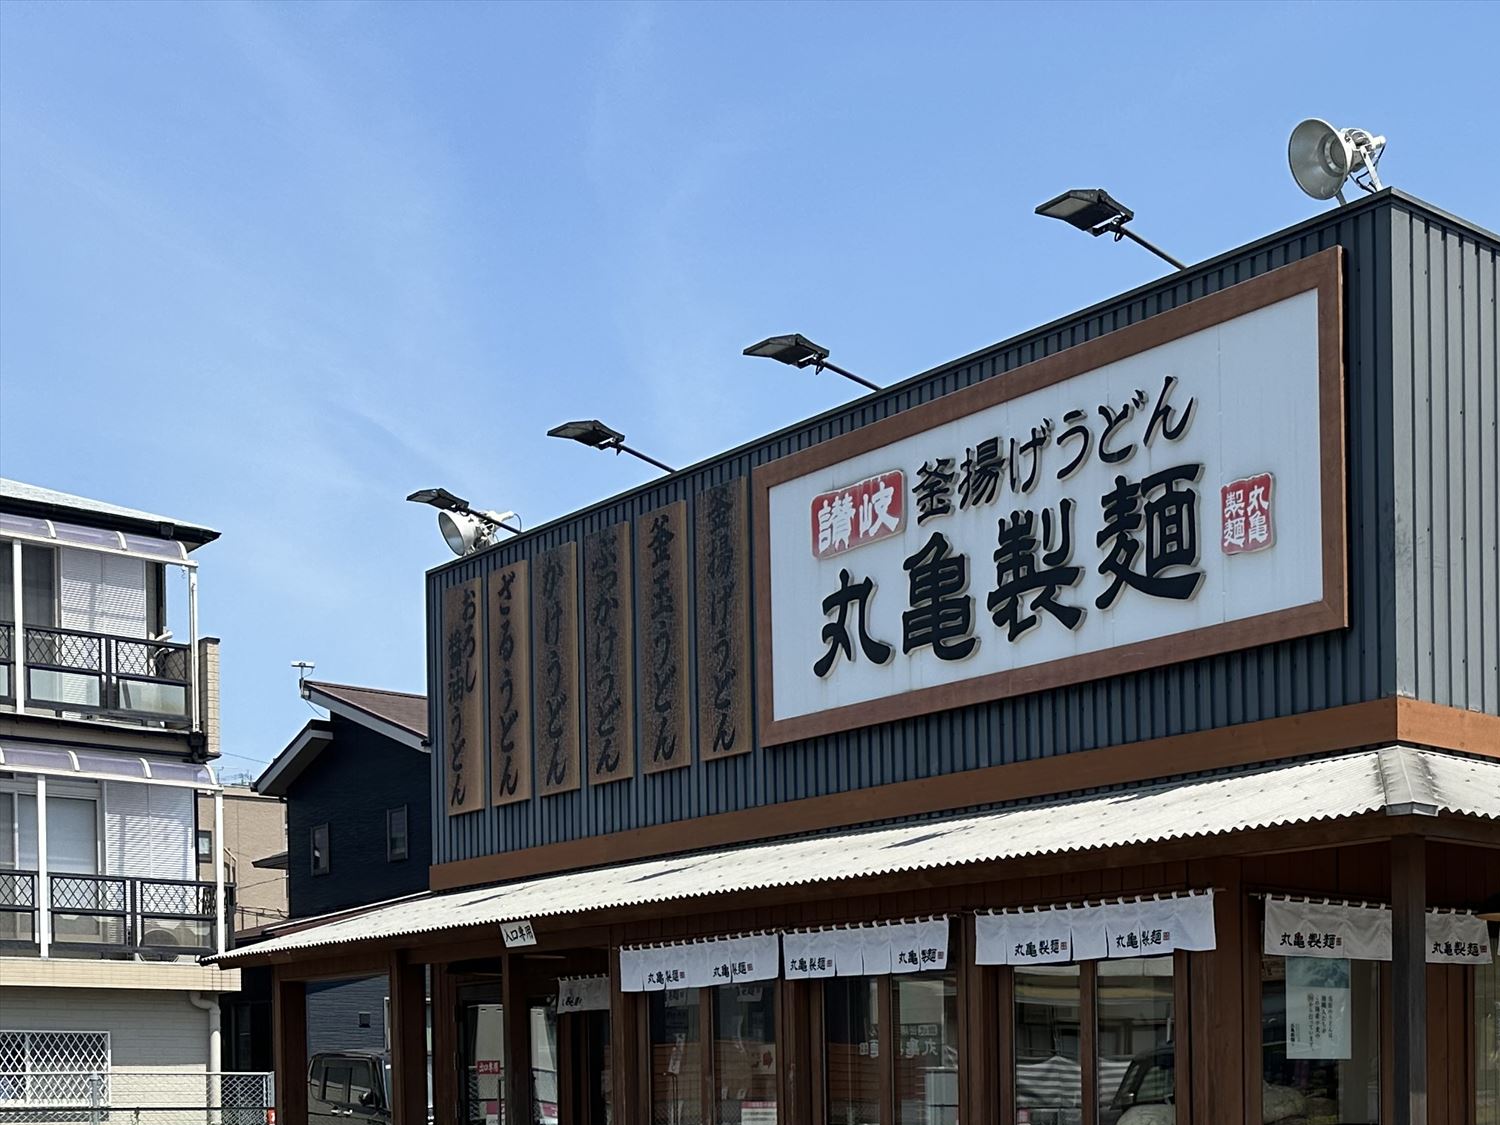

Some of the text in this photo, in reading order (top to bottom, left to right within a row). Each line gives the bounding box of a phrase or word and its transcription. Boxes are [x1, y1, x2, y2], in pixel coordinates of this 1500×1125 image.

[914, 375, 1198, 525] 釜揚げうどん
[813, 463, 1204, 678] 丸亀製麺
[498, 571, 519, 797] ざるうどん
[503, 925, 534, 943] 入口専用
[1116, 927, 1162, 949] 丸亀製麺
[1280, 932, 1336, 950] 丸亀製麺
[898, 948, 937, 965] 丸亀製麺
[1014, 938, 1060, 957] 丸亀製麺
[1431, 942, 1479, 958] 丸亀製麺
[713, 961, 747, 978] 丸亀製麺
[790, 956, 827, 972] 丸亀製麺
[647, 969, 680, 984] 丸亀製麺
